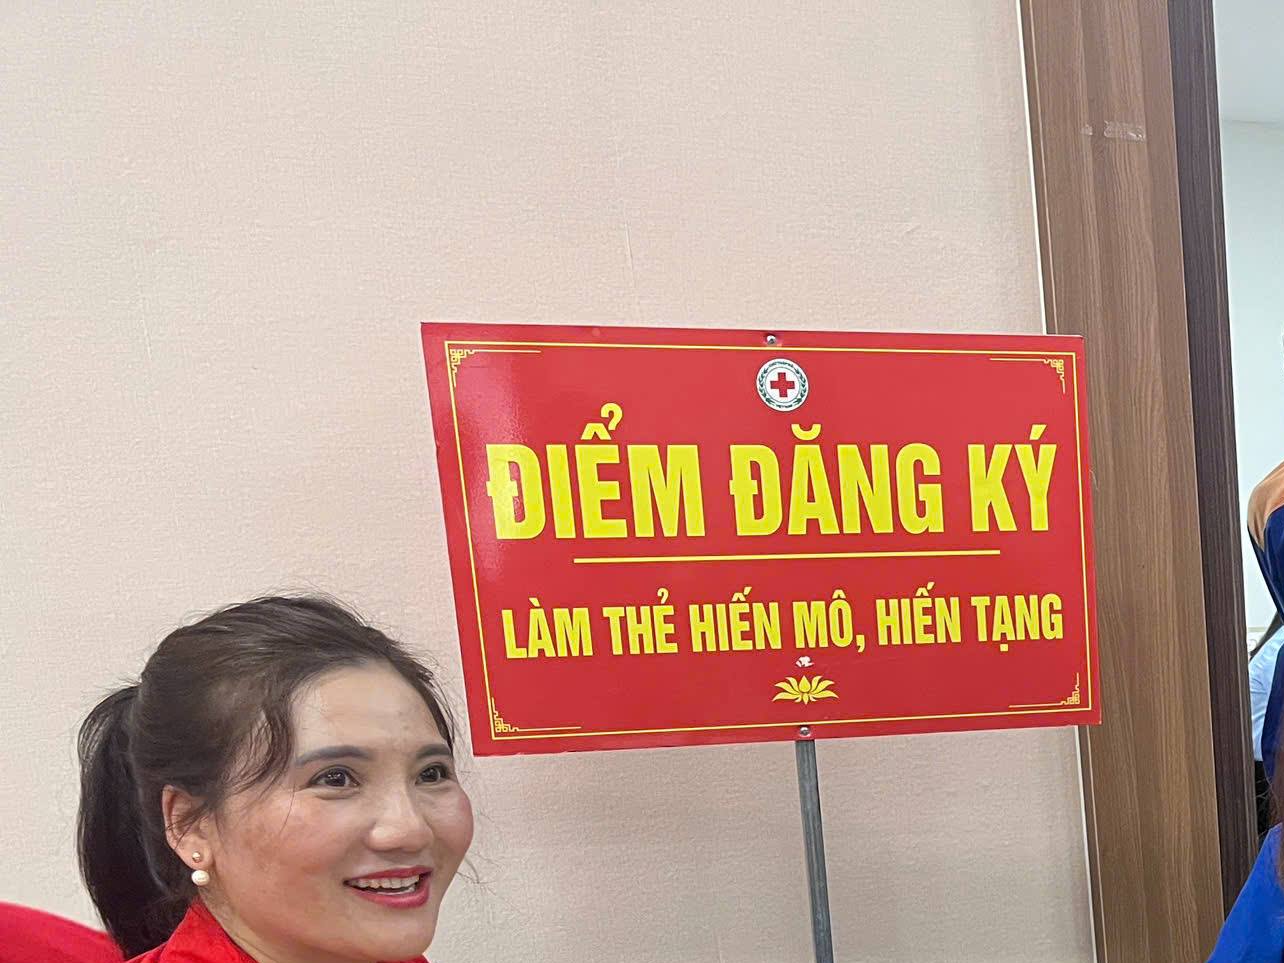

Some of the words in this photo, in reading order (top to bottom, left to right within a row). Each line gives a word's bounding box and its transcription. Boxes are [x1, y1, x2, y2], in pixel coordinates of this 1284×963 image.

[486, 403, 705, 540] ĐIỂM
[729, 424, 945, 536] ĐĂNG
[968, 424, 1057, 532] KÝ
[502, 598, 593, 659] LÀM
[602, 588, 678, 655] THẺ
[689, 586, 782, 652] HIẾN
[793, 590, 866, 653] MÔ,
[876, 581, 962, 646] HIẾN
[971, 593, 1064, 652] TẠNG
